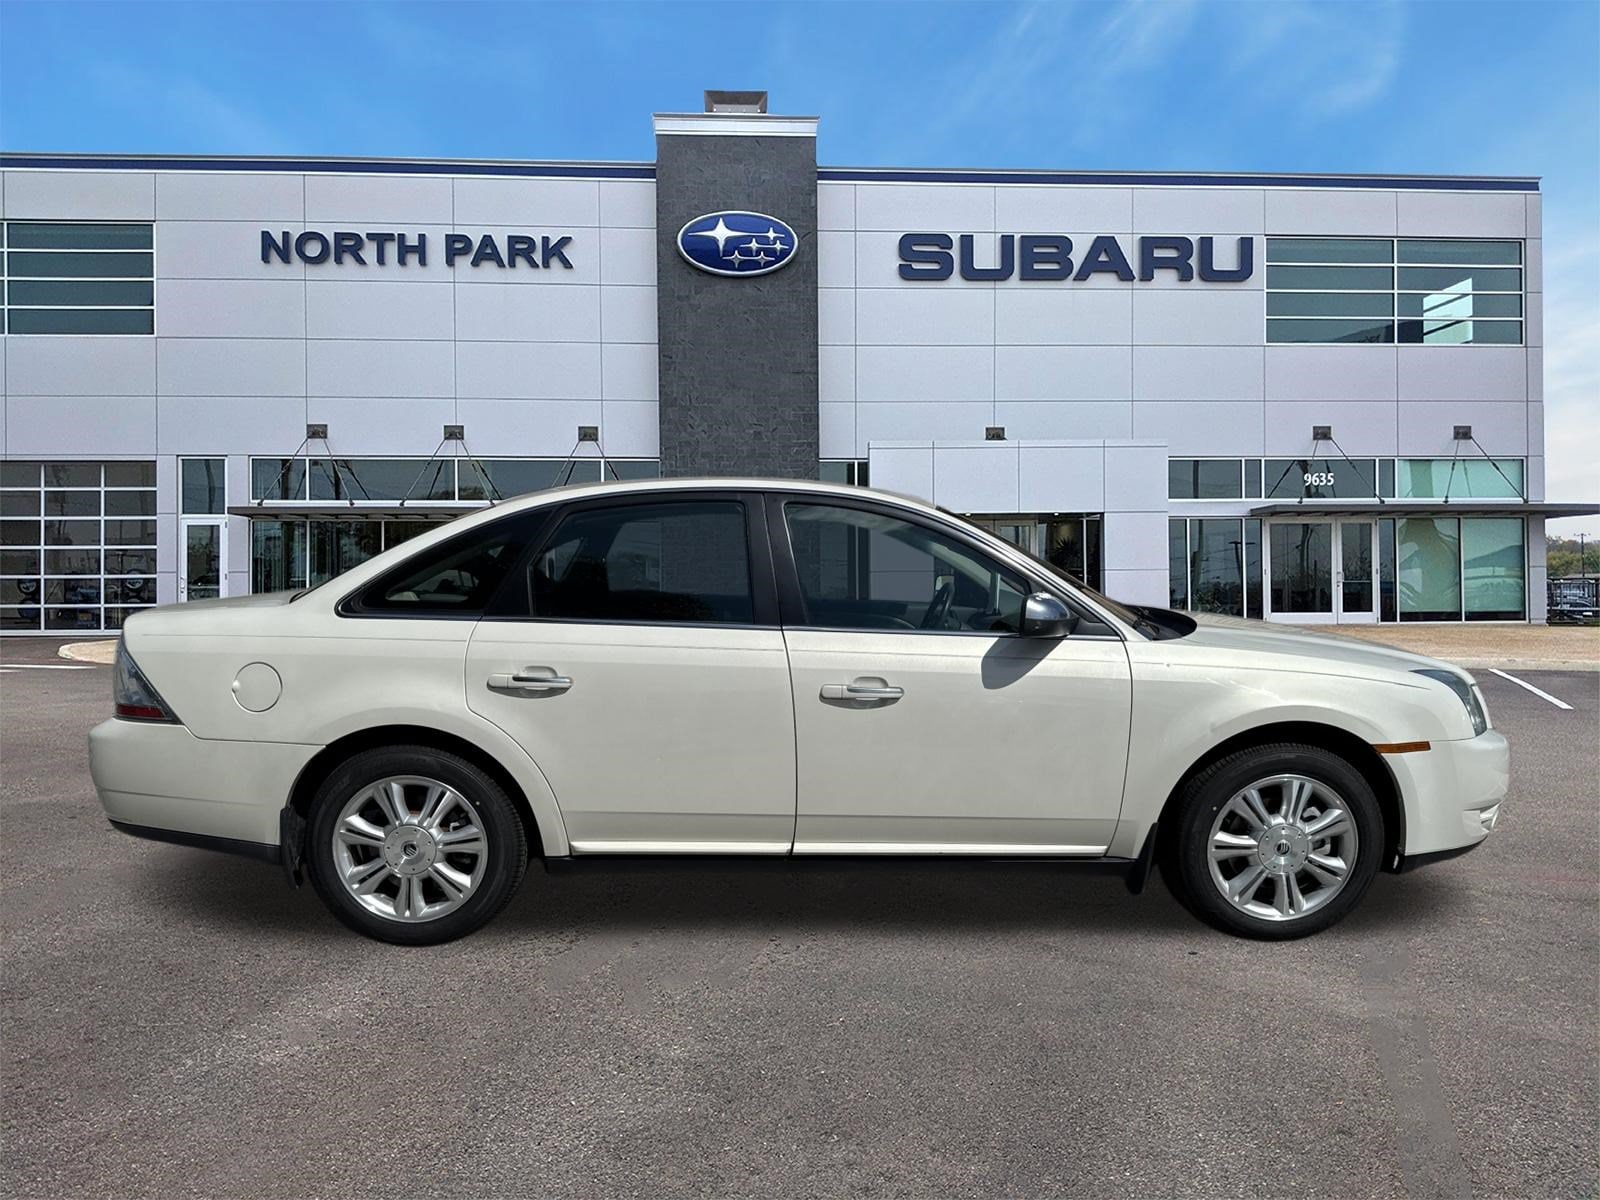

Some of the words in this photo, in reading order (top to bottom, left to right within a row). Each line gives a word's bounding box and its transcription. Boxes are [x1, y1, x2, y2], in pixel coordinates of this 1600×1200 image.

[261, 230, 427, 266] NORTH
[445, 234, 574, 269] PARK
[898, 233, 1254, 282] SUBARU
[1304, 473, 1334, 486] 9635
